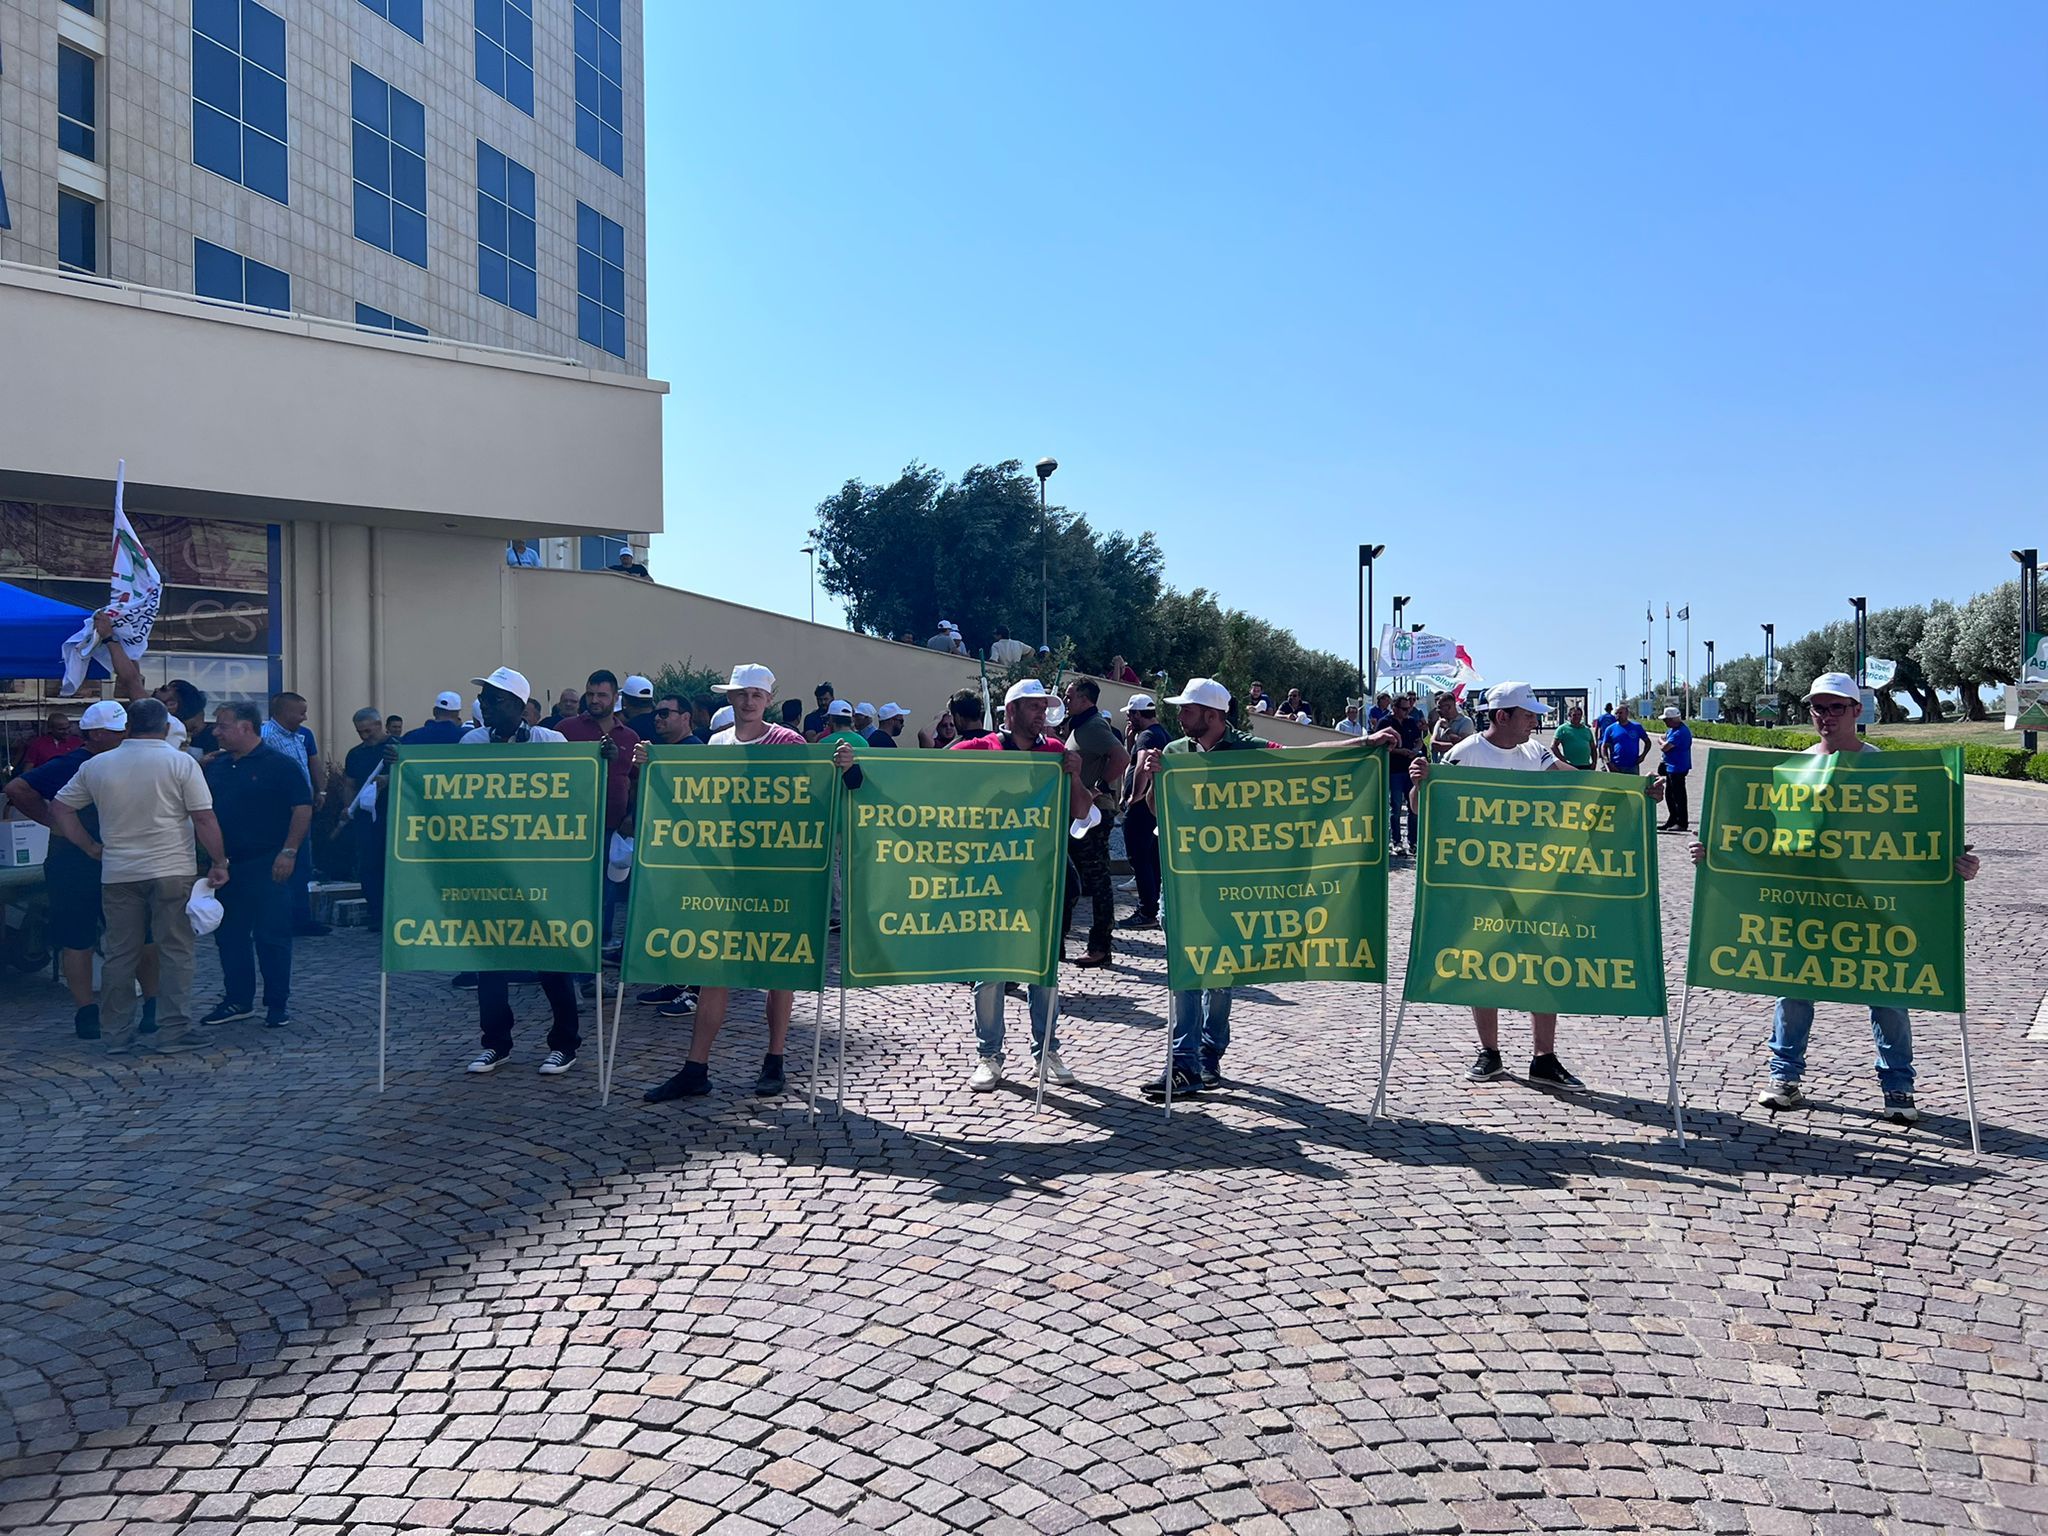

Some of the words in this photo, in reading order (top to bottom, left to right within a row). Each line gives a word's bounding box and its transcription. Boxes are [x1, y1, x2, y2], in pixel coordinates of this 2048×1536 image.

[186, 599, 257, 643] CS
[188, 661, 252, 701] KR
[423, 773, 570, 800] IMPRESE
[671, 776, 811, 804] IMPRESE
[1192, 774, 1354, 811] IMPRESE
[1744, 782, 1919, 814] IMPRESE
[406, 814, 587, 841] FORESTALI
[857, 804, 1051, 830] PROPRIETARI
[1456, 796, 1616, 833] IMPRESE
[650, 819, 825, 849] FORESTALI
[1177, 815, 1375, 853] FORESTALI
[1719, 824, 1942, 861] FORESTALI
[875, 839, 1035, 864] FORESTALI
[1434, 837, 1636, 877] FORESTALI
[441, 887, 525, 901] PROVINCIA
[529, 887, 547, 901] DI
[908, 874, 1002, 900] DELLA
[1218, 882, 1317, 901] PROVINCIA
[1321, 880, 1341, 895] DI
[1759, 887, 1869, 910] PROVINCIA
[1873, 895, 1896, 911] DI
[680, 895, 769, 912] PROVINCIA
[773, 899, 790, 913] DI
[393, 919, 594, 948] CATANZARO
[879, 908, 1031, 935] CALABRIA
[1231, 906, 1328, 940] VIBO
[1472, 916, 1571, 938] PROVINCIA
[1575, 924, 1597, 940] DI
[1737, 913, 1918, 957] REGGIO
[645, 927, 815, 964] COSENZA
[1184, 938, 1376, 975] VALENTIA
[1434, 947, 1636, 990] CROTONE
[1709, 945, 1945, 997] CALABRIA
